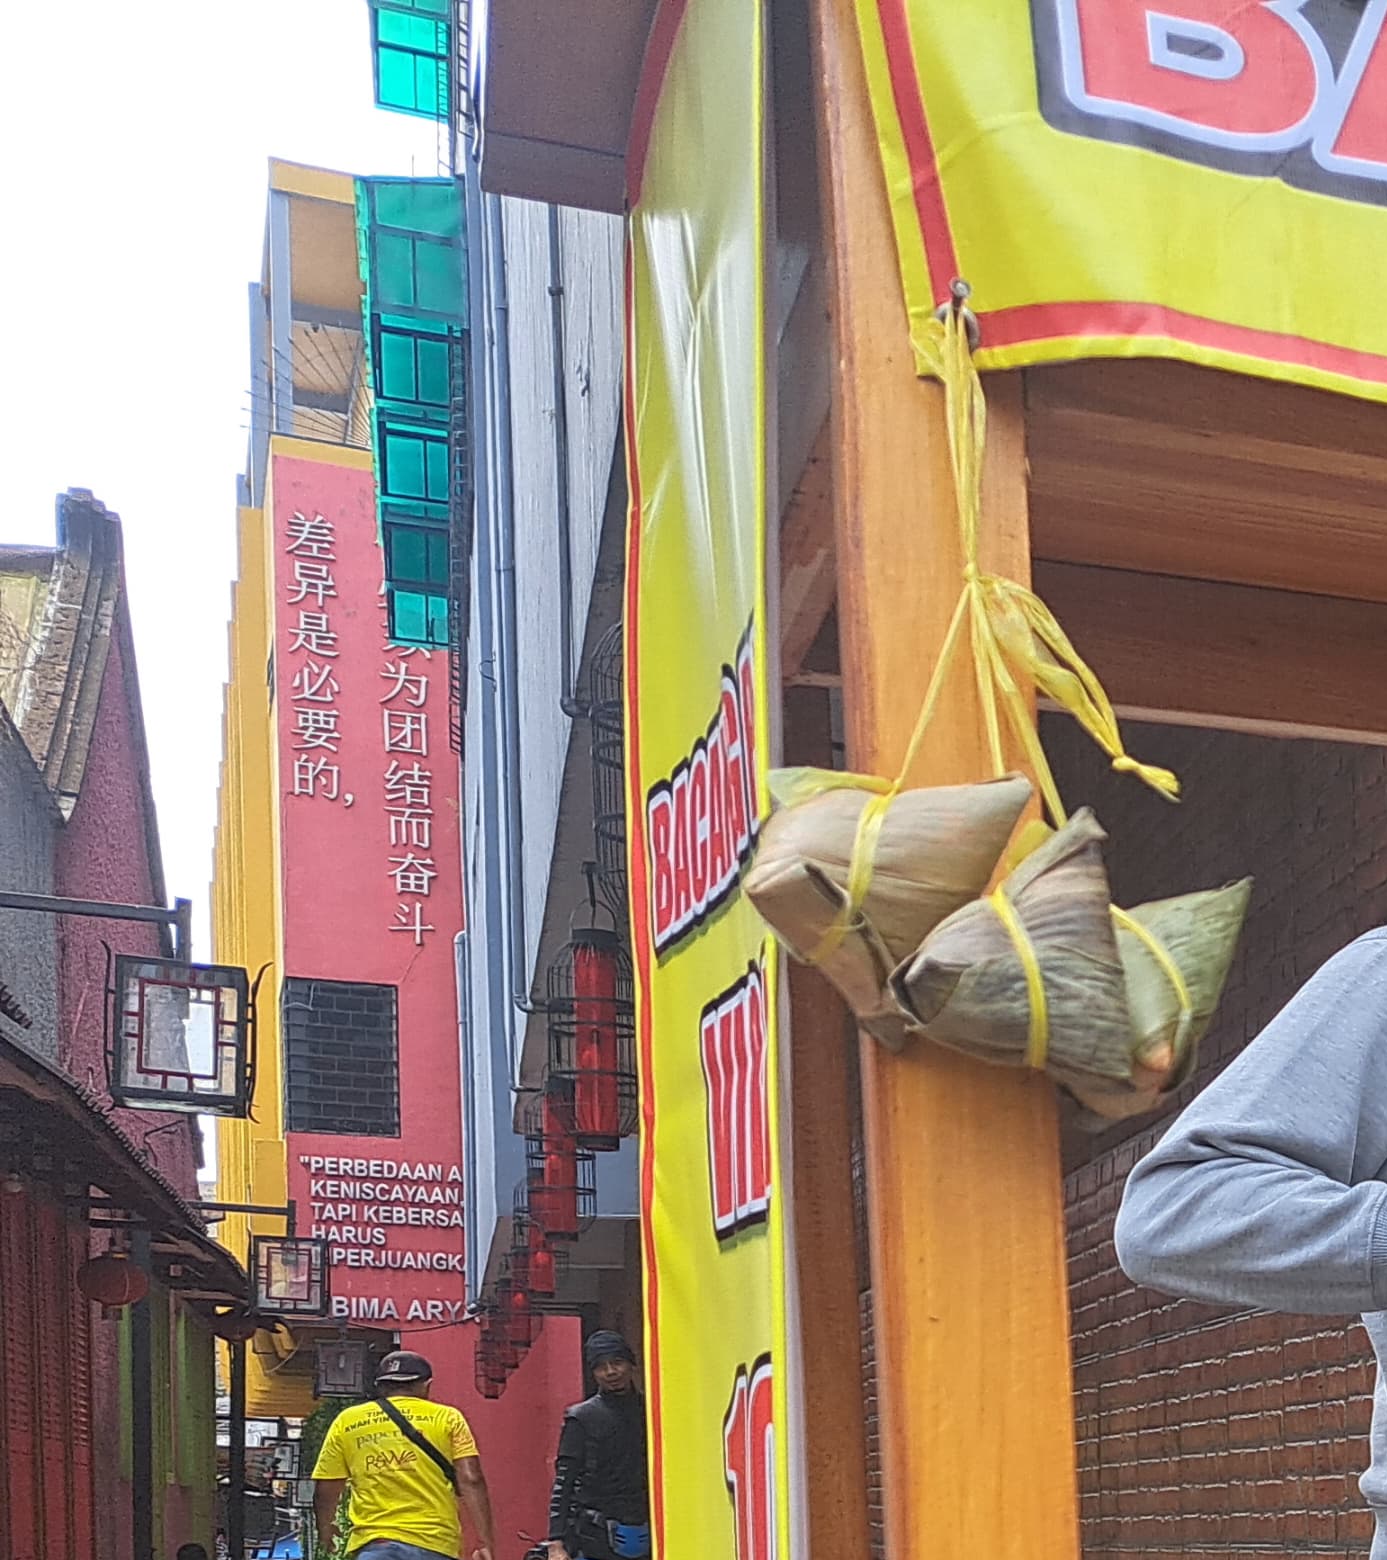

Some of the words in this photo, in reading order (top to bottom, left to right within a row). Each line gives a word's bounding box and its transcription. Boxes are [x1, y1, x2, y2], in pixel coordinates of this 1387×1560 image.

[379, 582, 438, 947] 为团结而奋斗
[310, 1202, 356, 1222] TAPI
[311, 1224, 386, 1245] HARUS
[331, 1296, 400, 1320] BIMA
